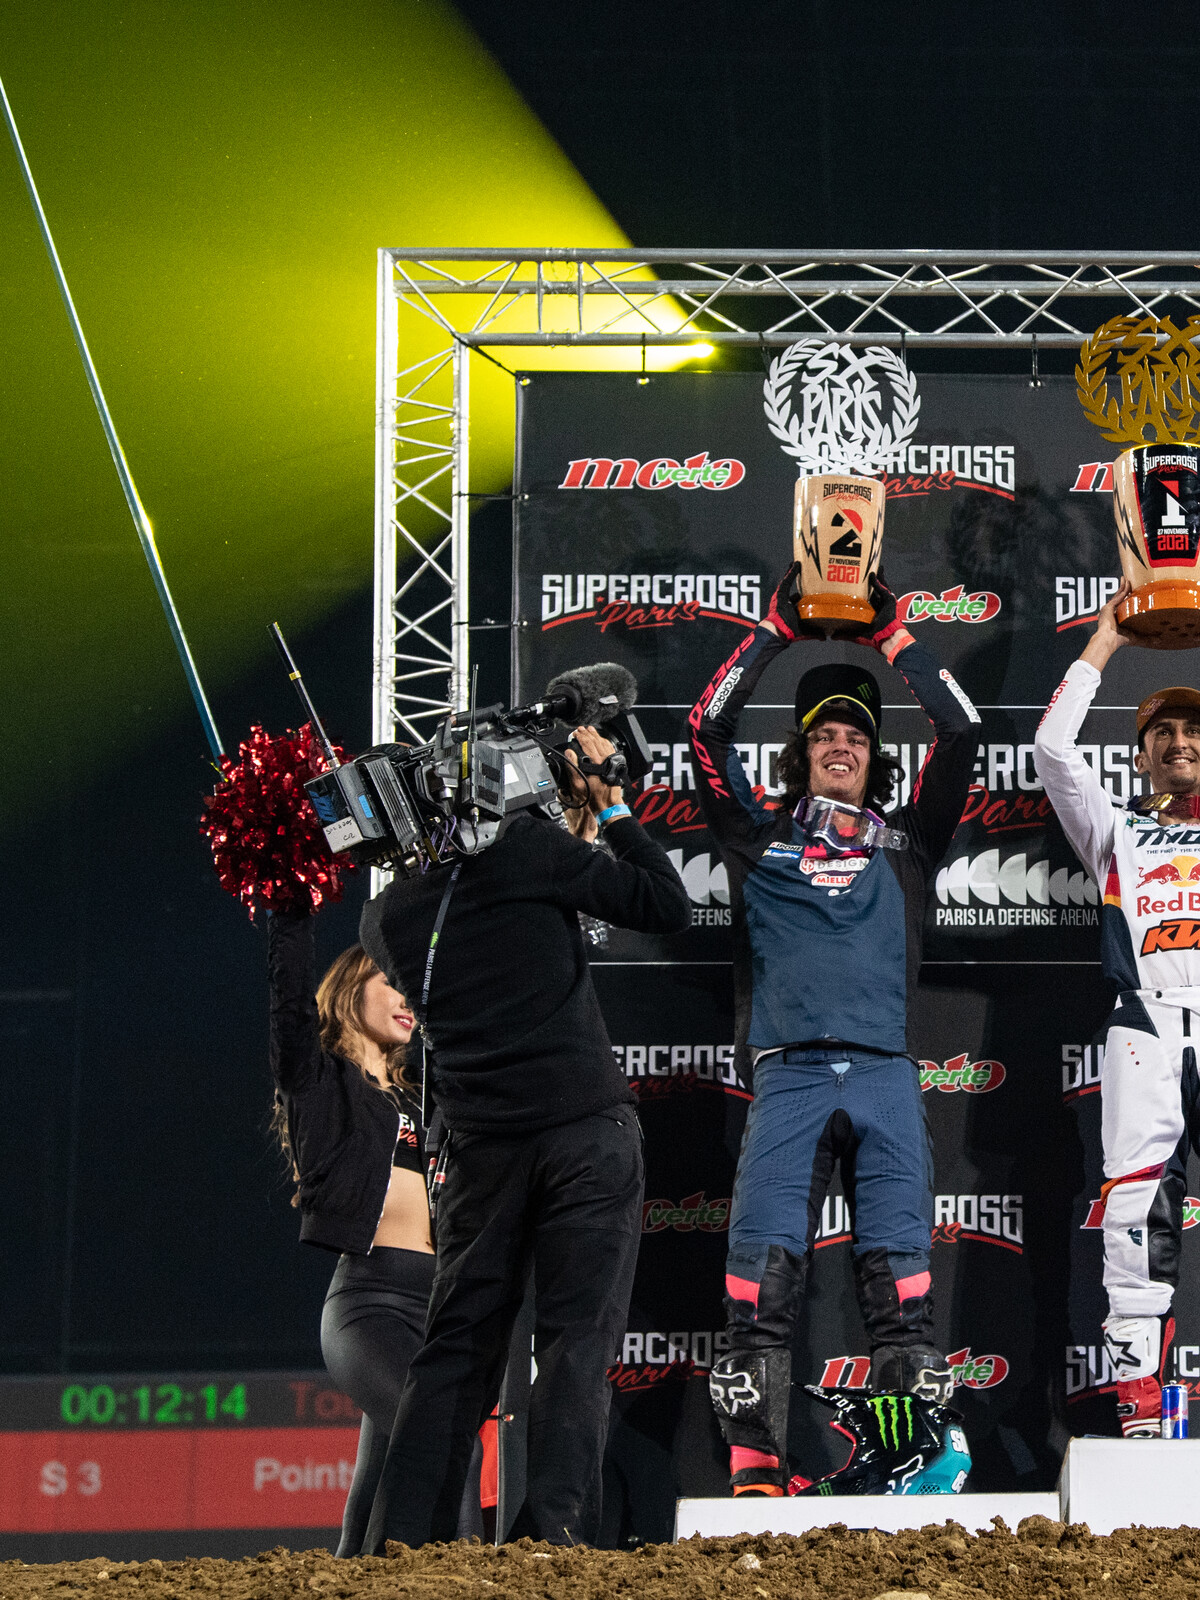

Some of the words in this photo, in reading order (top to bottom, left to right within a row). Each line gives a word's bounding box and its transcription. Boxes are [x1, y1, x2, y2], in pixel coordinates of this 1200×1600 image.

[558, 452, 746, 491] moto
[656, 465, 730, 482] verte
[823, 483, 872, 502] SUPERCROSS
[829, 508, 863, 558] 2
[1157, 535, 1189, 551] 2021
[827, 565, 860, 584] 2021
[542, 574, 760, 622] SUPERCROSS
[897, 584, 1001, 623] oto
[911, 598, 986, 616] verte
[594, 599, 700, 633] Paris
[1136, 891, 1184, 917] Red
[936, 908, 977, 926] PARIS
[979, 908, 996, 926] LA
[998, 908, 1057, 926] DEFENSE
[1060, 908, 1099, 926] ARENA
[651, 1206, 728, 1224] verte
[60, 1383, 247, 1424] 00:12:14
[830, 1393, 857, 1413] FOX
